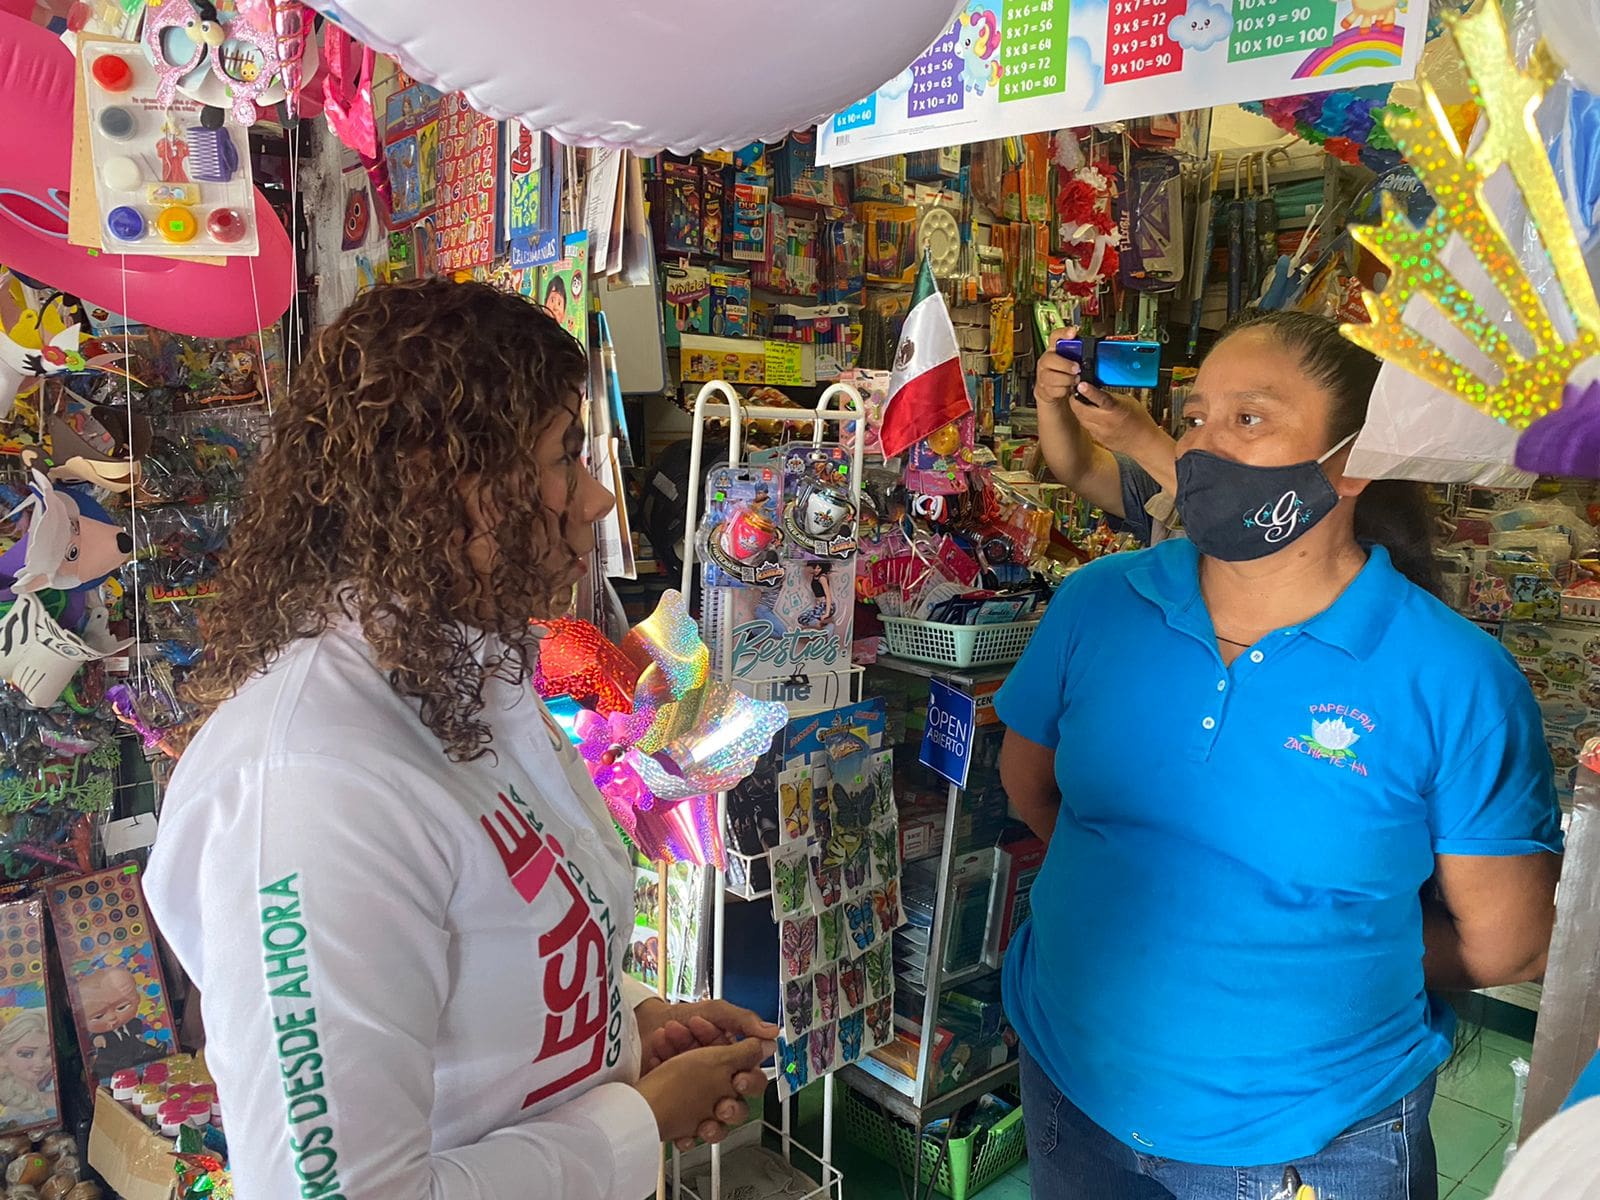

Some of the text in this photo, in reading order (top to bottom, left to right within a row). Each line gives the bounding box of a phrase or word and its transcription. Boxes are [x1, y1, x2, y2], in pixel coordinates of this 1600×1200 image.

[926, 727, 965, 757] ABIERTO
[929, 706, 968, 742] OPEN
[258, 872, 312, 999] AHORA
[273, 1006, 328, 1125] DESDE
